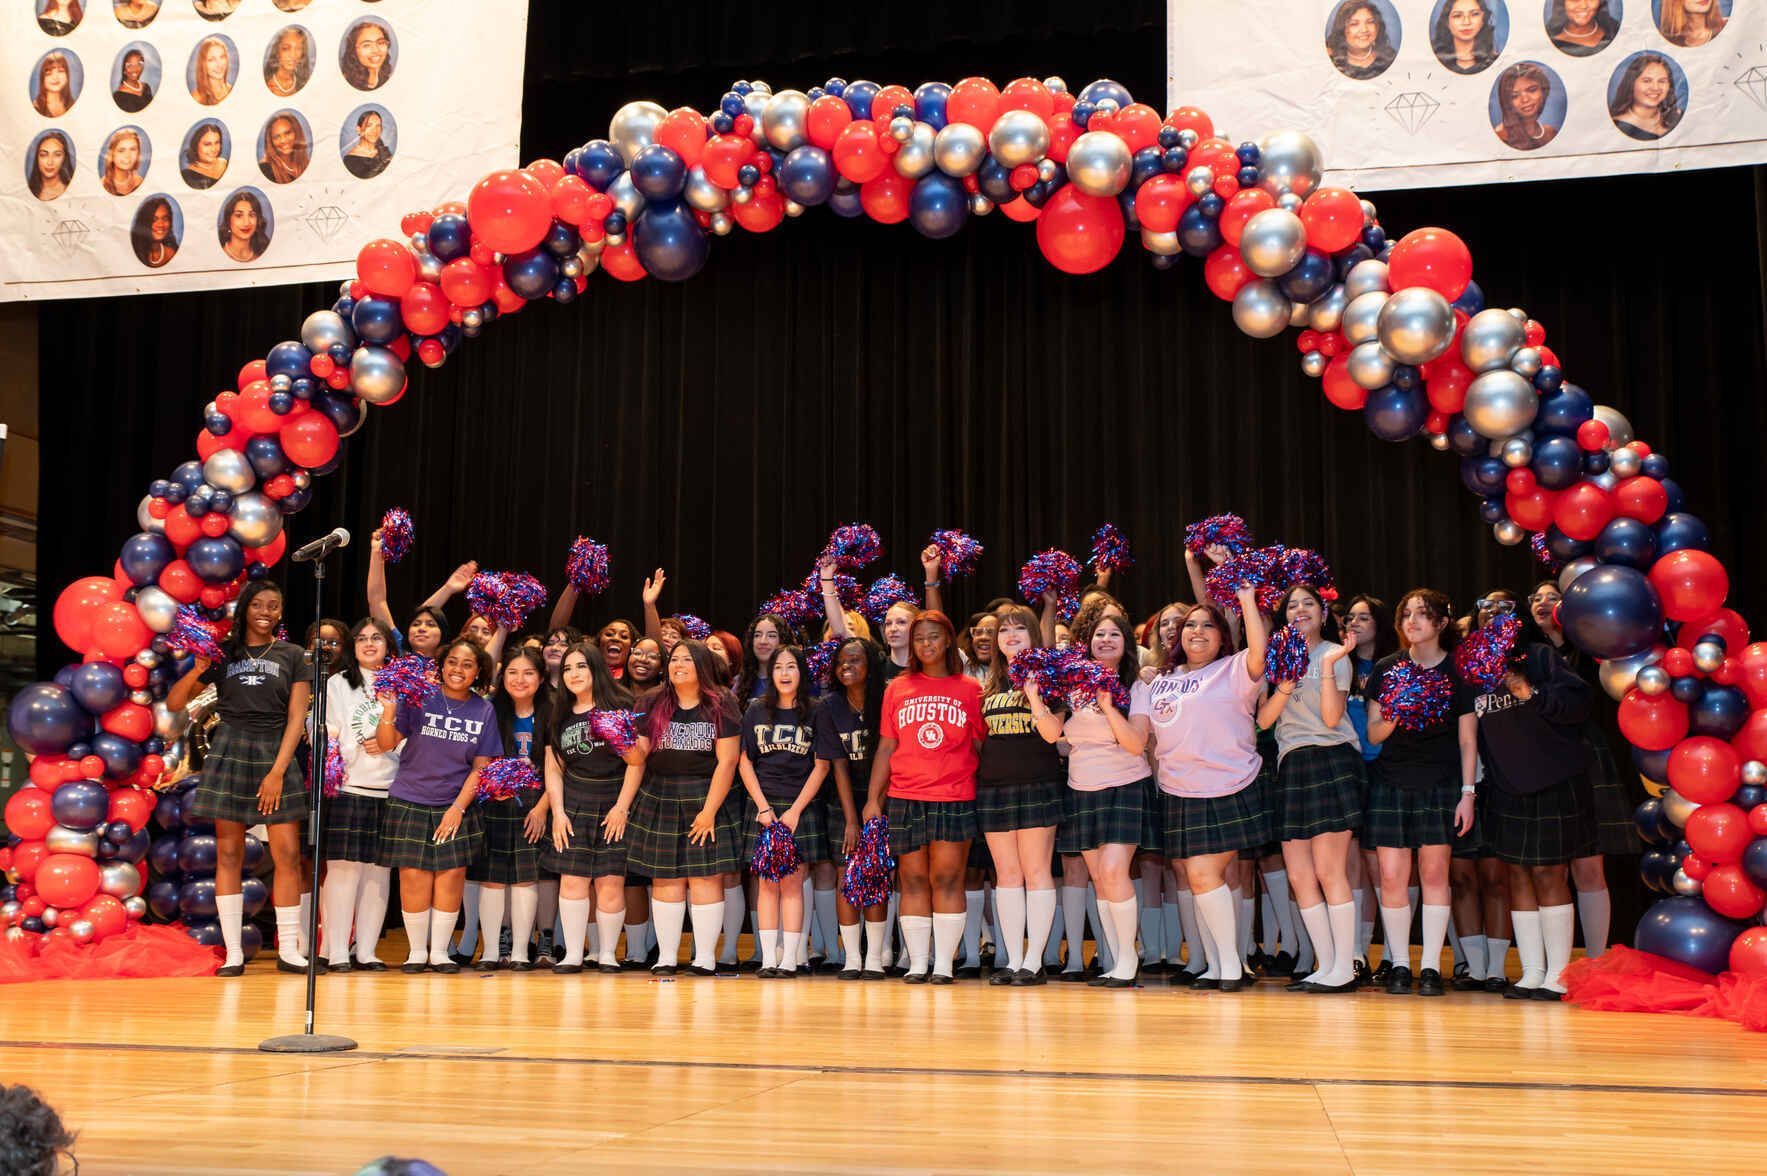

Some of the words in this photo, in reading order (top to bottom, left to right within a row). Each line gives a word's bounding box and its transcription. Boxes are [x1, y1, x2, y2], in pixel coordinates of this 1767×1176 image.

[227, 659, 280, 678] HAMPTON
[905, 695, 951, 706] UNIVERSITY
[953, 699, 962, 707] OF
[424, 712, 484, 735] TCU
[898, 702, 967, 730] HOUSTON
[421, 725, 448, 739] HORNED
[448, 731, 469, 743] FROGS
